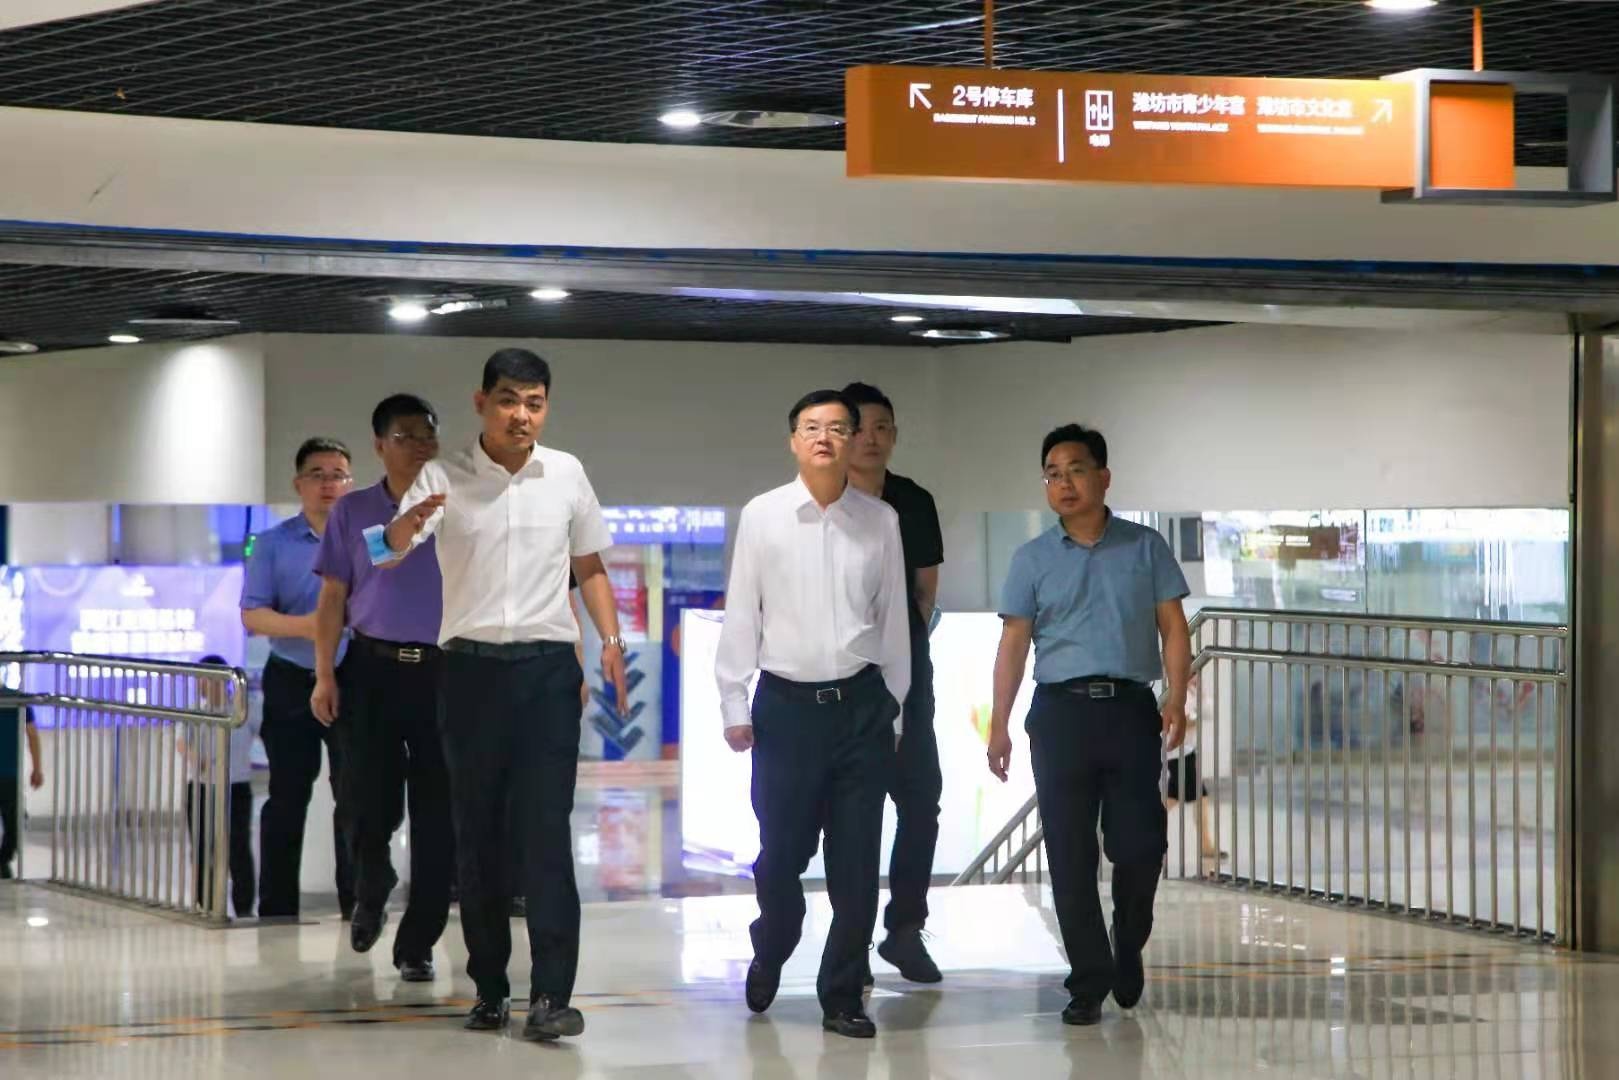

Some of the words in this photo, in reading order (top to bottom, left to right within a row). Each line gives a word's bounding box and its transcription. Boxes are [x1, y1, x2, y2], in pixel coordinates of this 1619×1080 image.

[953, 85, 1034, 109] 2号停车库
[1132, 92, 1246, 116] 潍坊市青少年宫
